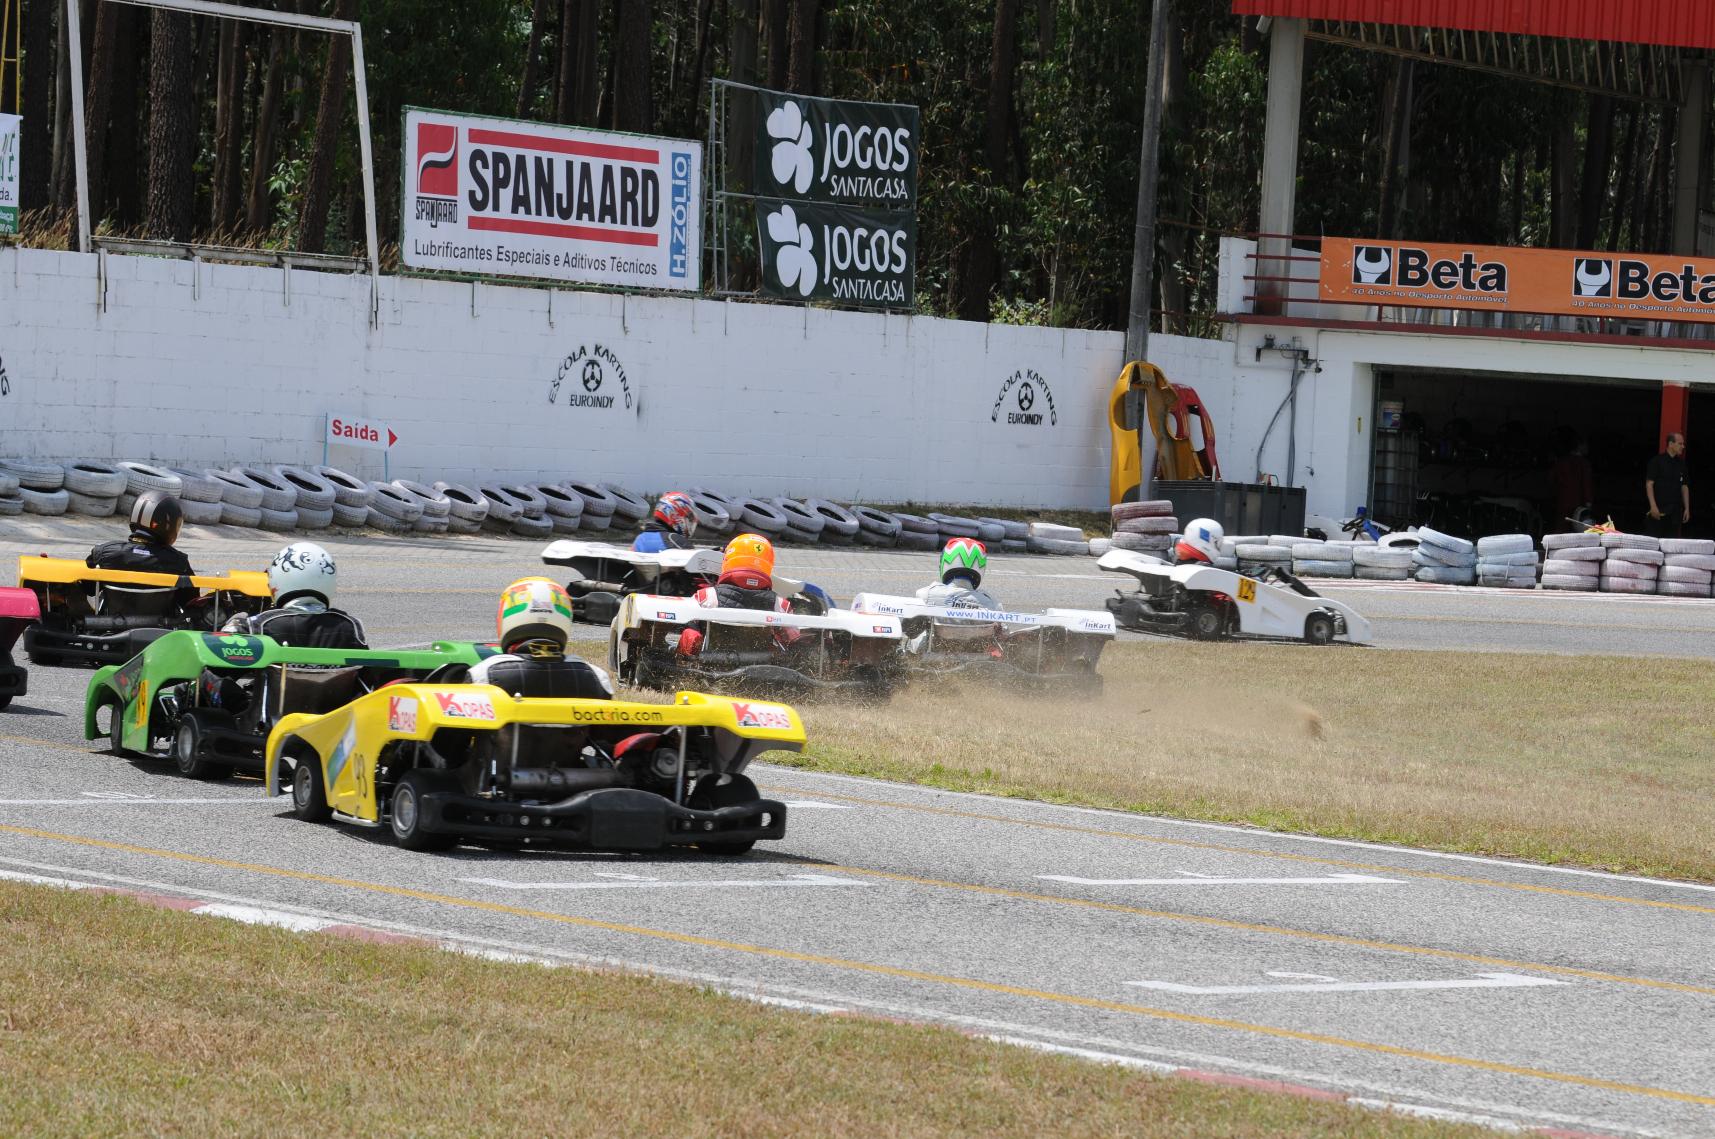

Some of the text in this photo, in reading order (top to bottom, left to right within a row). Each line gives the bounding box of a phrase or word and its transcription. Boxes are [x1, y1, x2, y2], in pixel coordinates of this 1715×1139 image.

[820, 122, 910, 183] JOGOS
[468, 148, 660, 228] SPANJAARD
[416, 199, 458, 228] SPANJAARD
[414, 238, 657, 276] Lubrificantes Especiais e Aditivos Técnicos
[824, 224, 907, 285] JOGOS
[1397, 248, 1507, 294] Beta
[1617, 260, 1715, 305] Beta
[548, 344, 633, 410] ESCOLA KARTING
[991, 368, 1058, 426] ESCOLA KARTING
[569, 394, 615, 409] EUROINDY
[1007, 412, 1043, 425] EUROINDY
[222, 647, 254, 658] JOGOS
